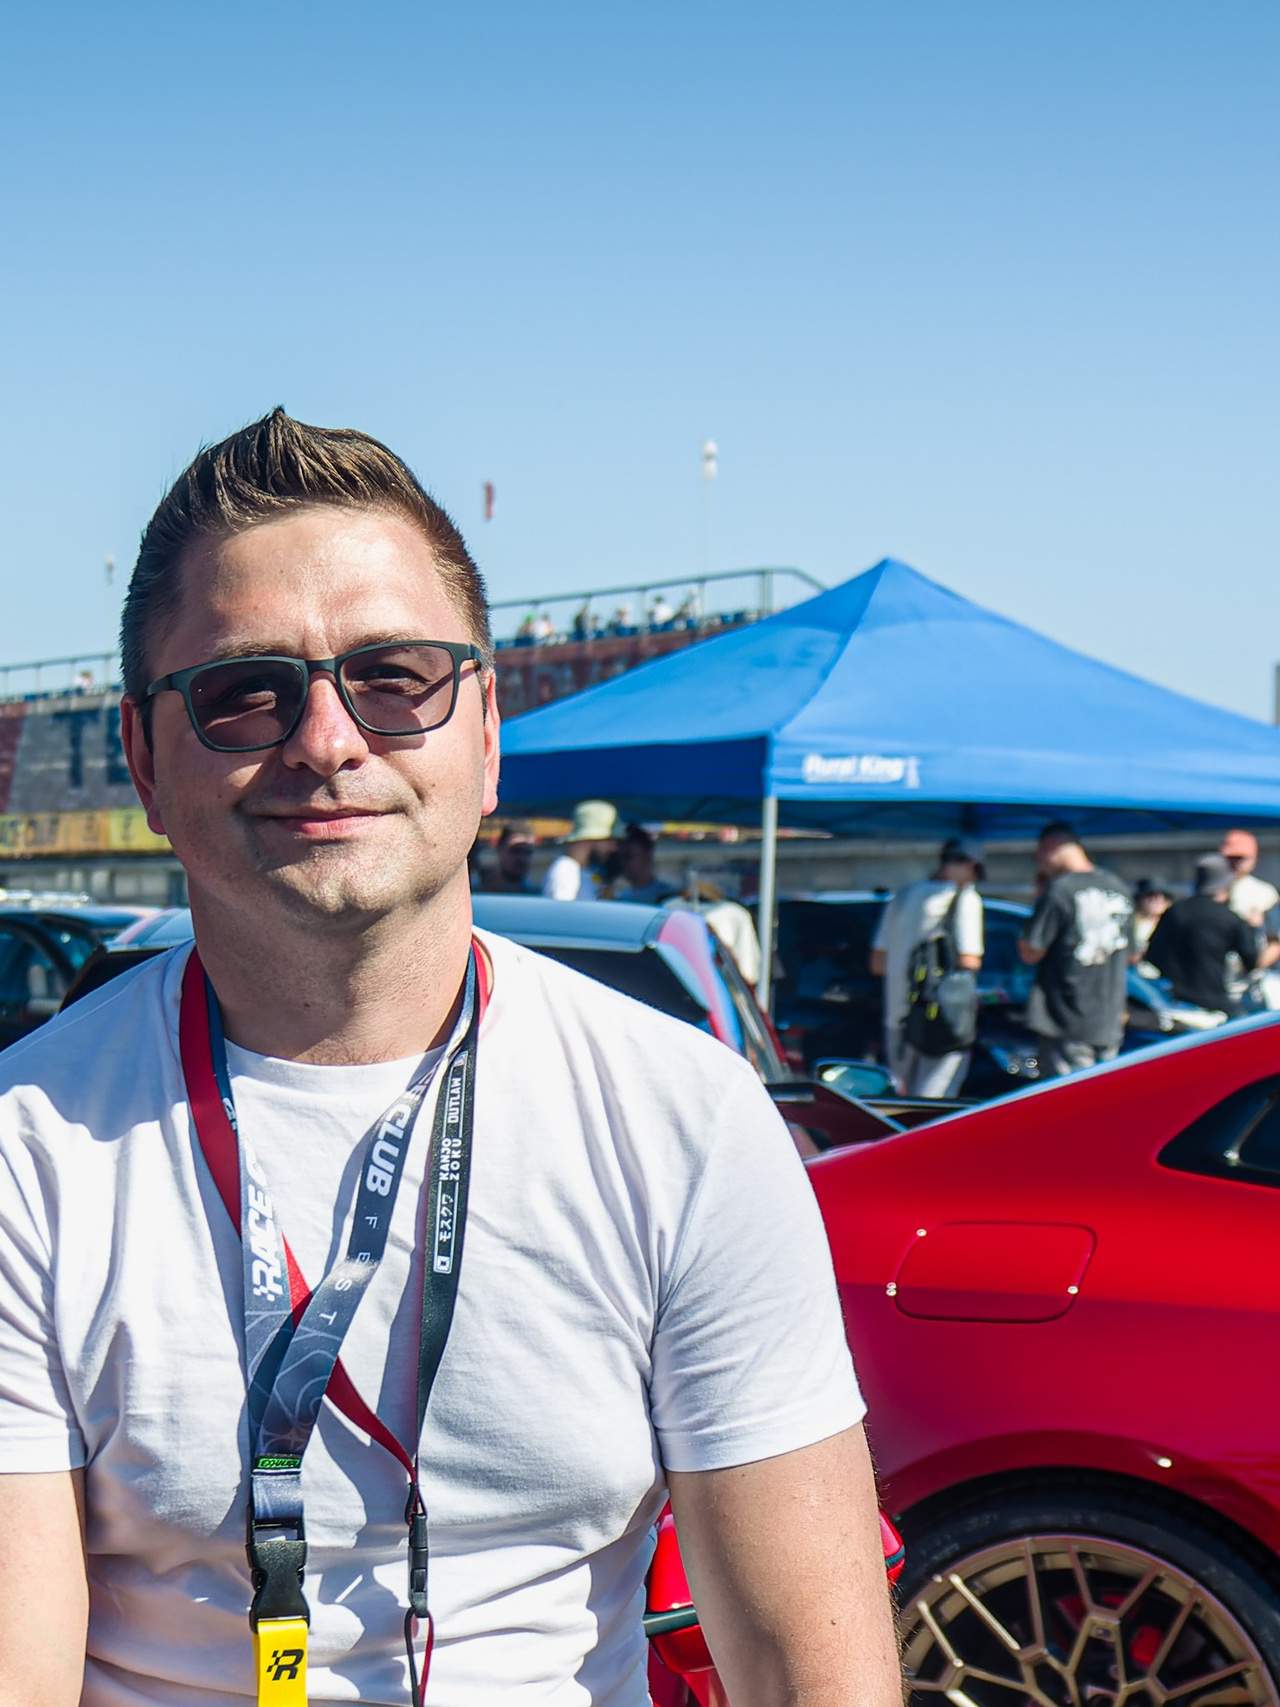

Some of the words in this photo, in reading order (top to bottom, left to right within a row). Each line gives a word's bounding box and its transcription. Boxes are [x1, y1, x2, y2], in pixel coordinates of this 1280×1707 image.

[447, 1077, 463, 1124] OUTLAW
[366, 1104, 412, 1197] CLUB
[439, 1137, 452, 1181] KANJO
[449, 1138, 463, 1182] ZOKU
[439, 1193, 454, 1242] モスクワ
[247, 1184, 284, 1302] RACE
